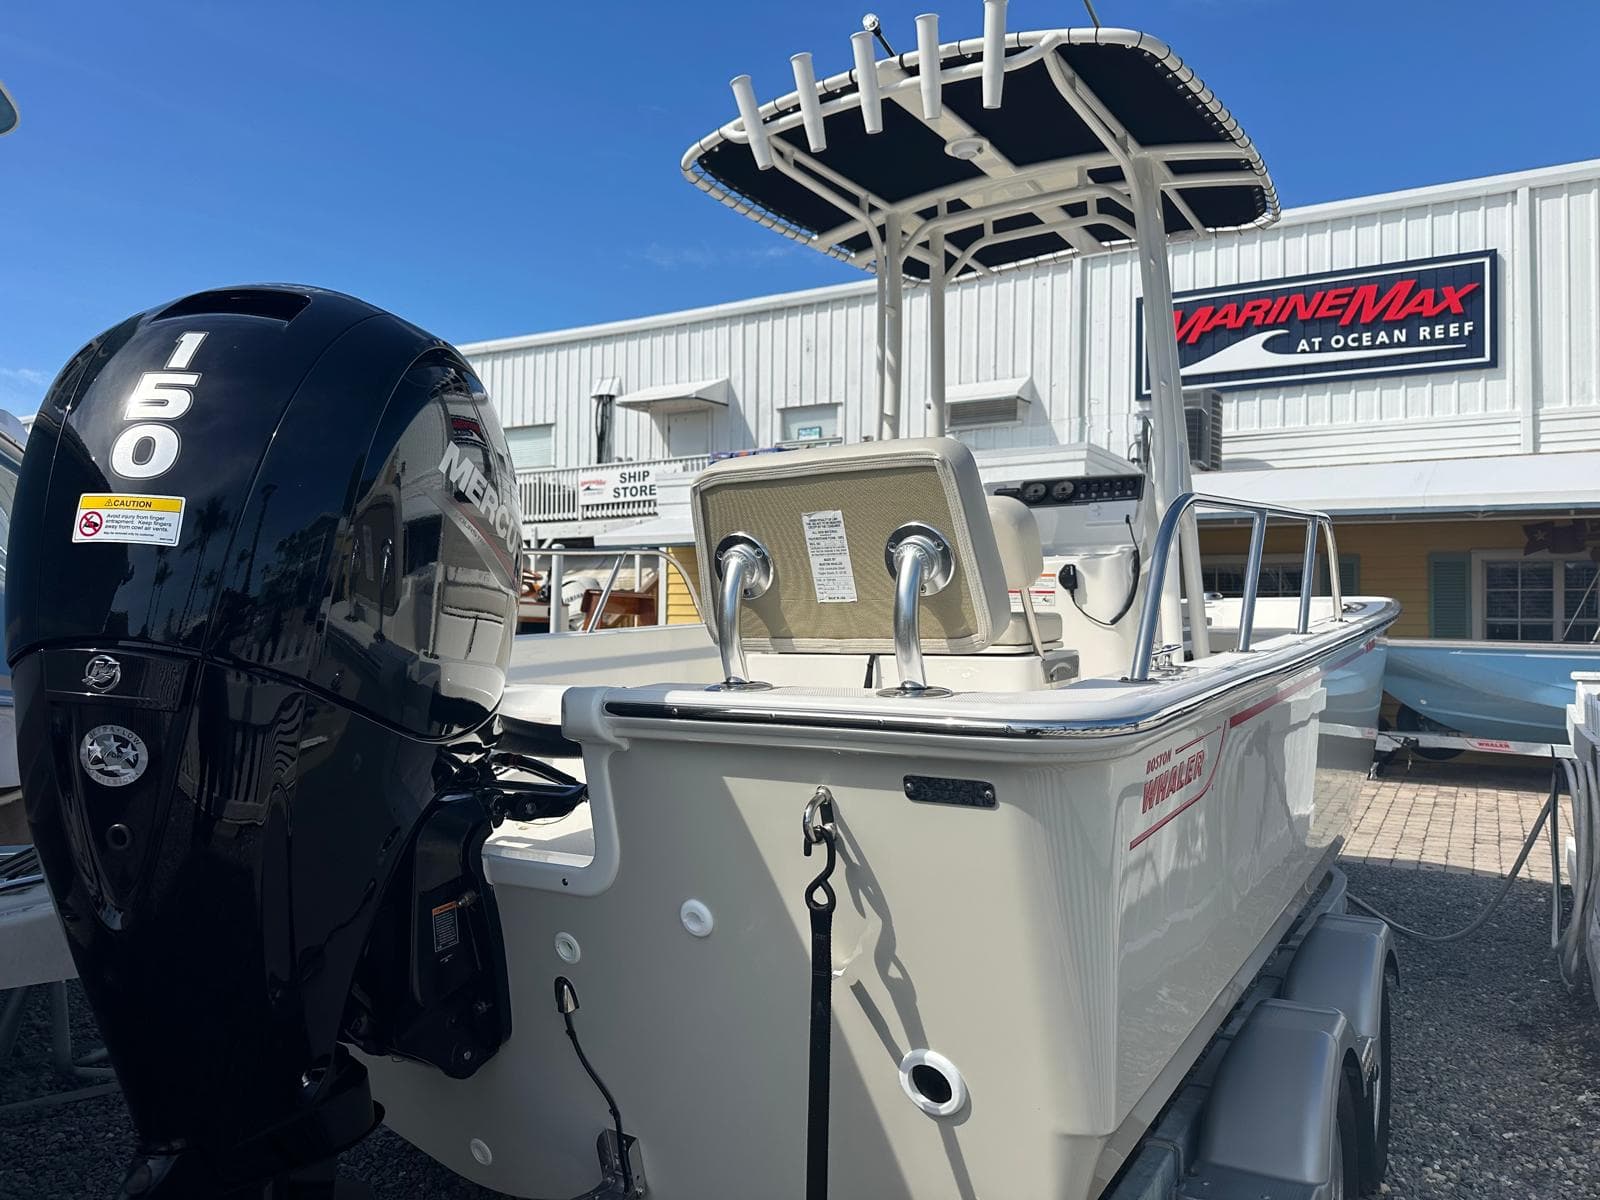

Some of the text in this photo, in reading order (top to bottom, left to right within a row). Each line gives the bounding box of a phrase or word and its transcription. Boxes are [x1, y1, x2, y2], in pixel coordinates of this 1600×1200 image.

[1297, 321, 1475, 352] AT OCEAN REEF
[109, 331, 209, 480] 150
[619, 470, 650, 484] SHIP
[613, 484, 657, 498] STORE
[113, 499, 152, 508] CAUTION
[122, 729, 143, 745] LOW
[1146, 748, 1173, 774] BOSTON
[1142, 750, 1205, 814] WHALER
